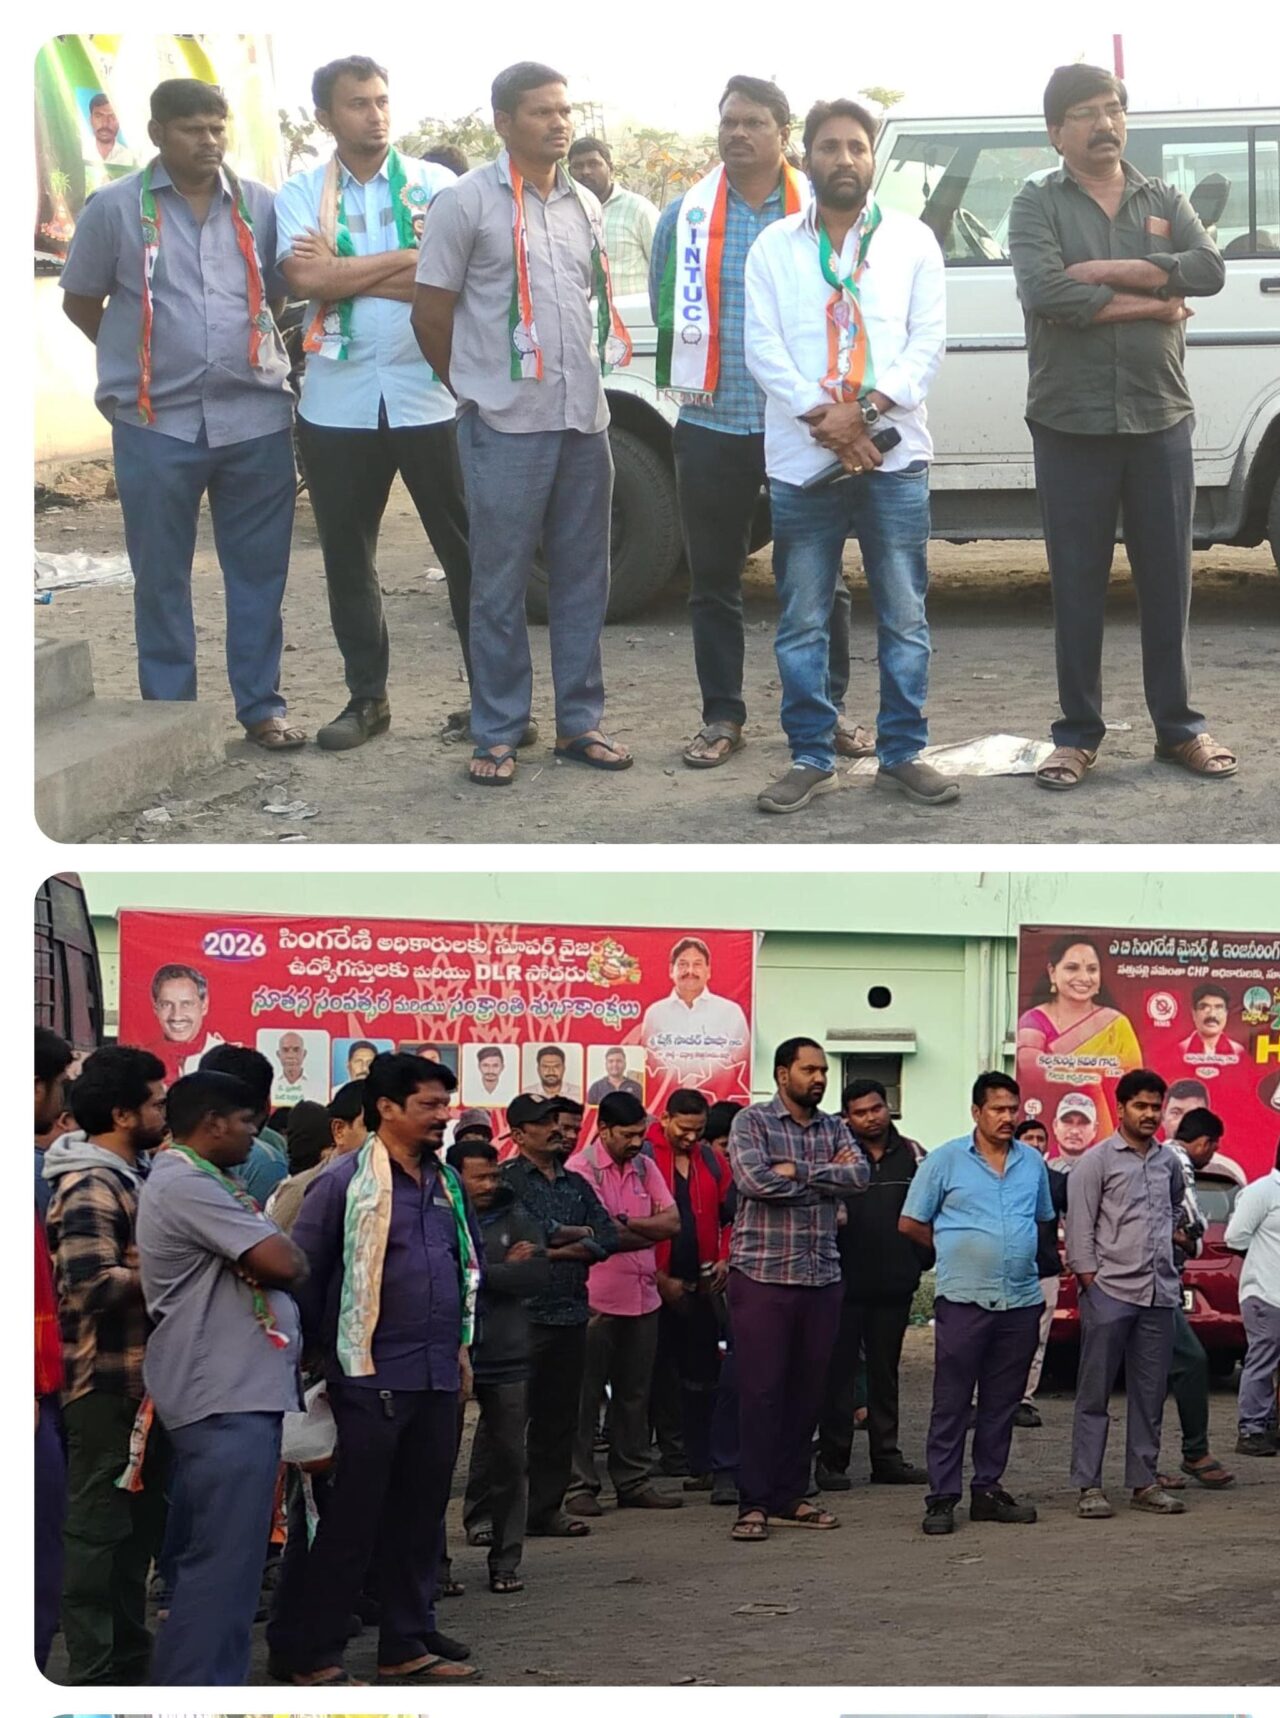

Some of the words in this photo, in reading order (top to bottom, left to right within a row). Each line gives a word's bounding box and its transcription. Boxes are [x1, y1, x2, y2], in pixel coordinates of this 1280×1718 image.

[682, 227, 703, 322] INTUC
[204, 932, 267, 956] 2026
[278, 925, 373, 951] సింగరేణి
[495, 936, 556, 955] సూపర్
[1131, 935, 1175, 957] సింగరేణి
[1210, 941, 1220, 958] &
[287, 956, 410, 984] ఉద్యోగస్తులకు
[413, 965, 472, 980] మరియు
[475, 963, 522, 981] DLR
[1187, 966, 1210, 978] CHP
[251, 985, 313, 1018] నూతన
[313, 986, 391, 1022] సంవత్సర
[393, 997, 447, 1014] మరియు
[448, 991, 526, 1023] సంక్రాంతి
[528, 993, 641, 1031] శుభాకాంక్షలు
